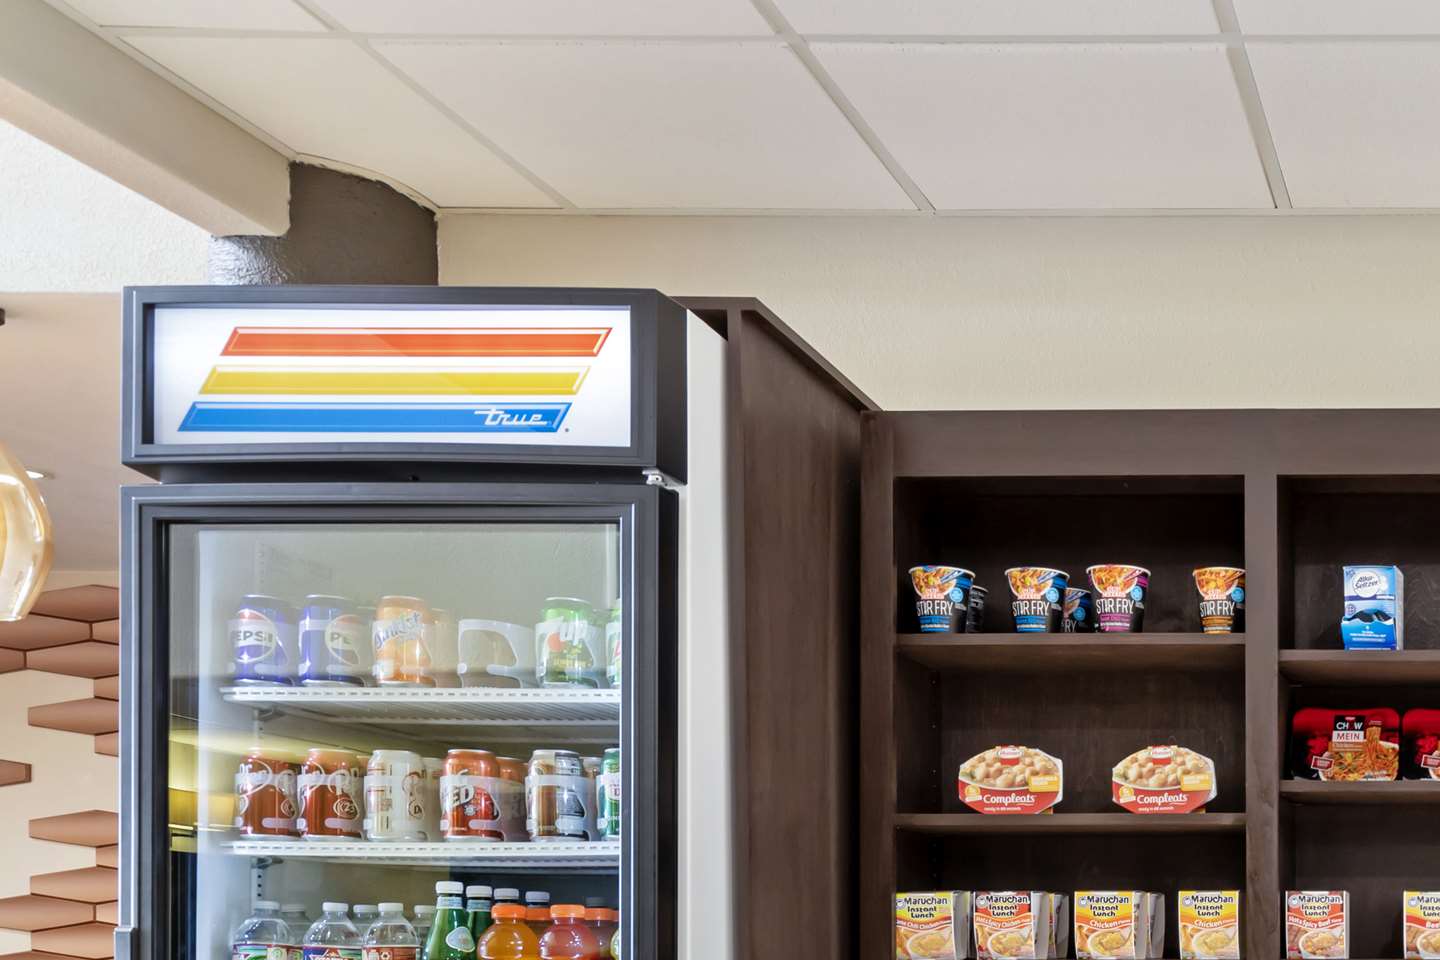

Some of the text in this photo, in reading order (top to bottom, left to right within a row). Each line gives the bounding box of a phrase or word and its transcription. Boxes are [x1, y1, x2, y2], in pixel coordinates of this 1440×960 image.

[474, 408, 548, 426] true
[934, 600, 953, 616] FRY
[1030, 600, 1050, 616] FRY
[1116, 600, 1135, 615] FRY
[1217, 601, 1235, 617] FRY
[233, 630, 273, 642] EPSI
[983, 792, 1035, 806] Compleats
[1136, 791, 1188, 805] Compleats
[904, 896, 948, 905] Maruchan
[985, 895, 1028, 904] Maruchan
[1087, 895, 1129, 904] Maruchan
[1191, 895, 1234, 903] Maruchan
[1298, 895, 1341, 904] Maruchan
